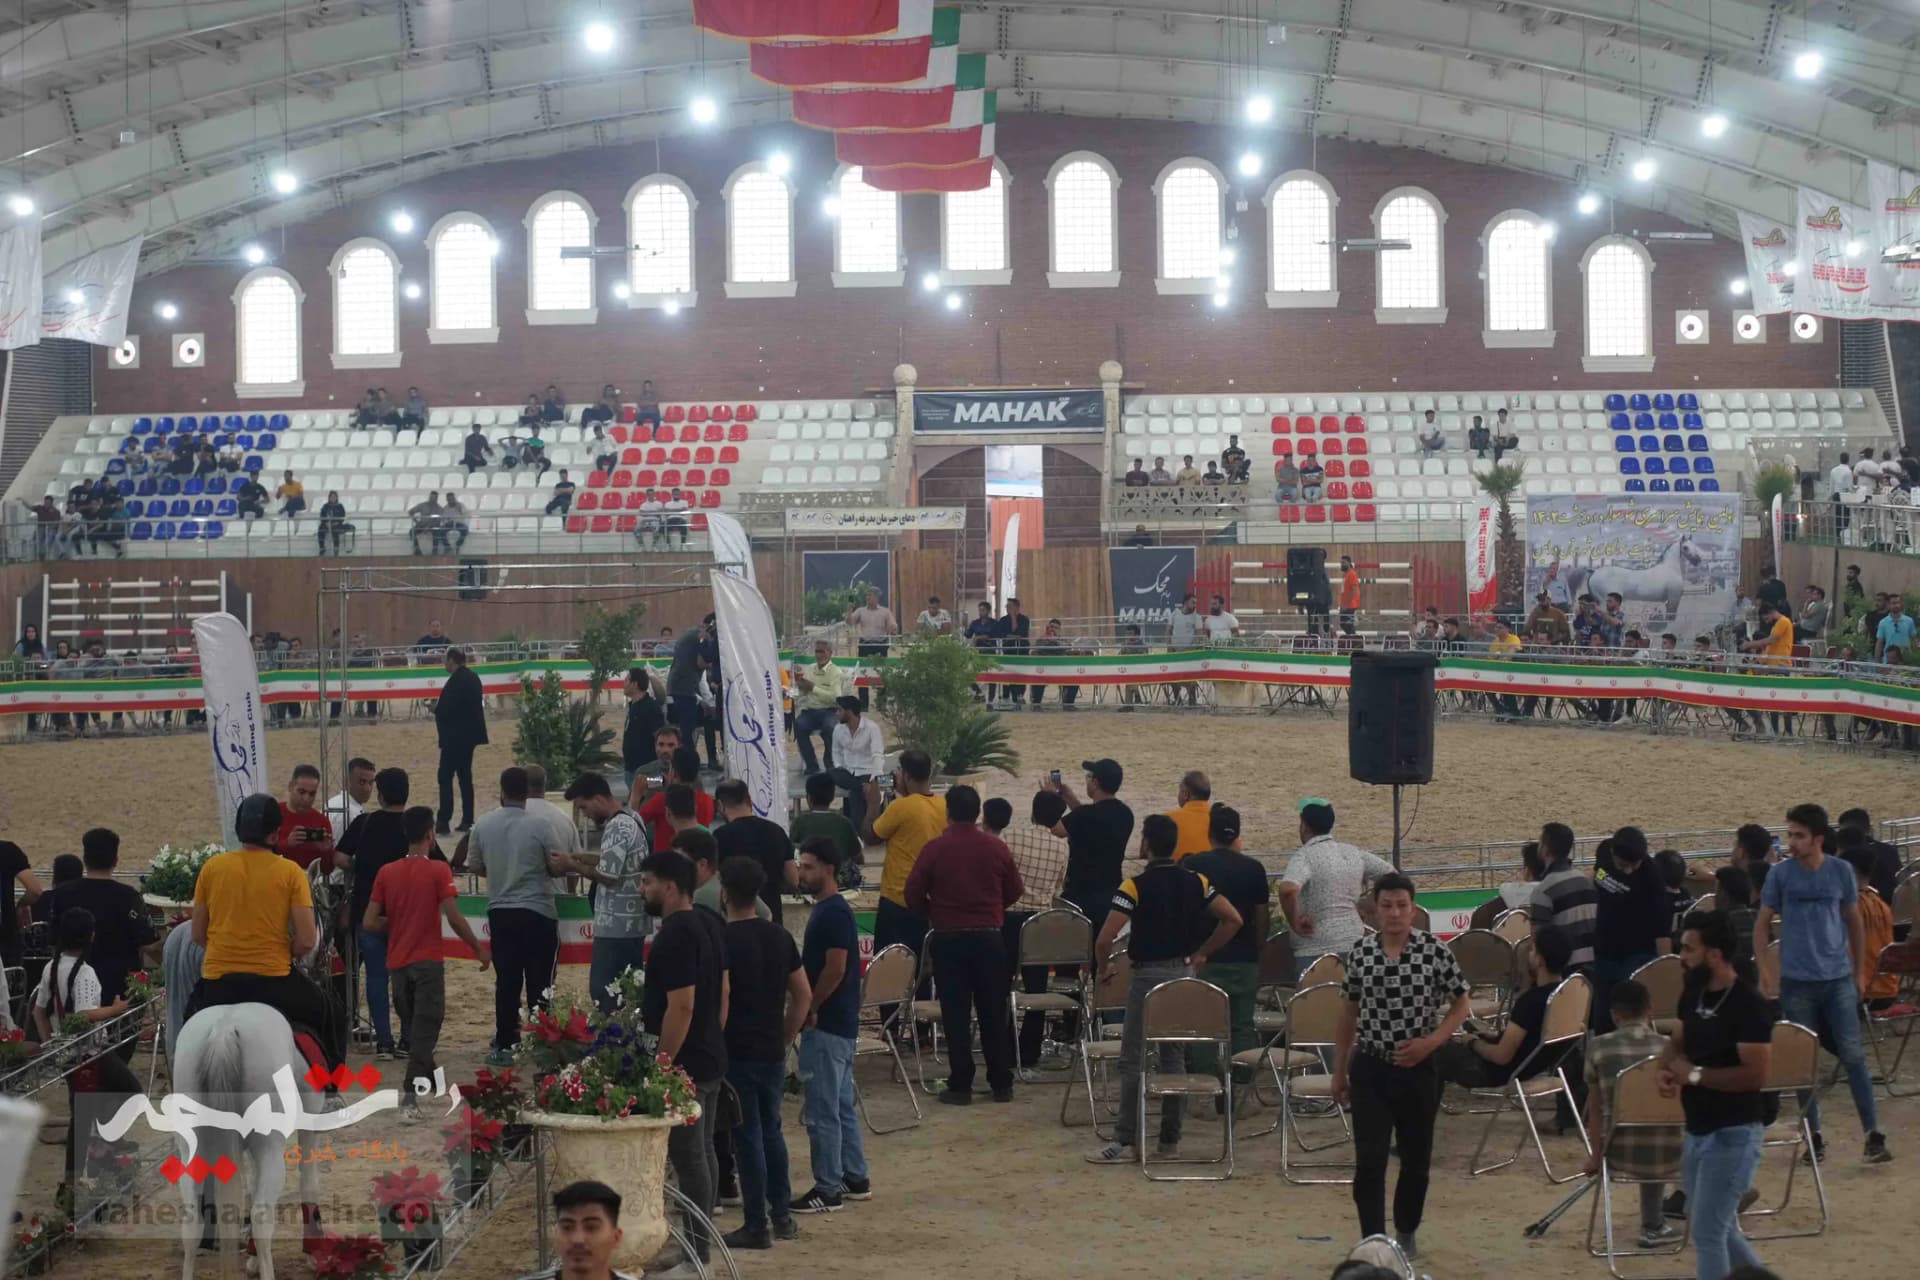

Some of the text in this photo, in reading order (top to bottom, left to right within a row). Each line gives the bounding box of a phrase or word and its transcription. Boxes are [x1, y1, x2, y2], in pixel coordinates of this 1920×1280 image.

[954, 401, 1067, 423] MAHAK
[1119, 607, 1174, 622] MAHA
[245, 691, 257, 766] Riding Club
[768, 703, 776, 747] Riding
